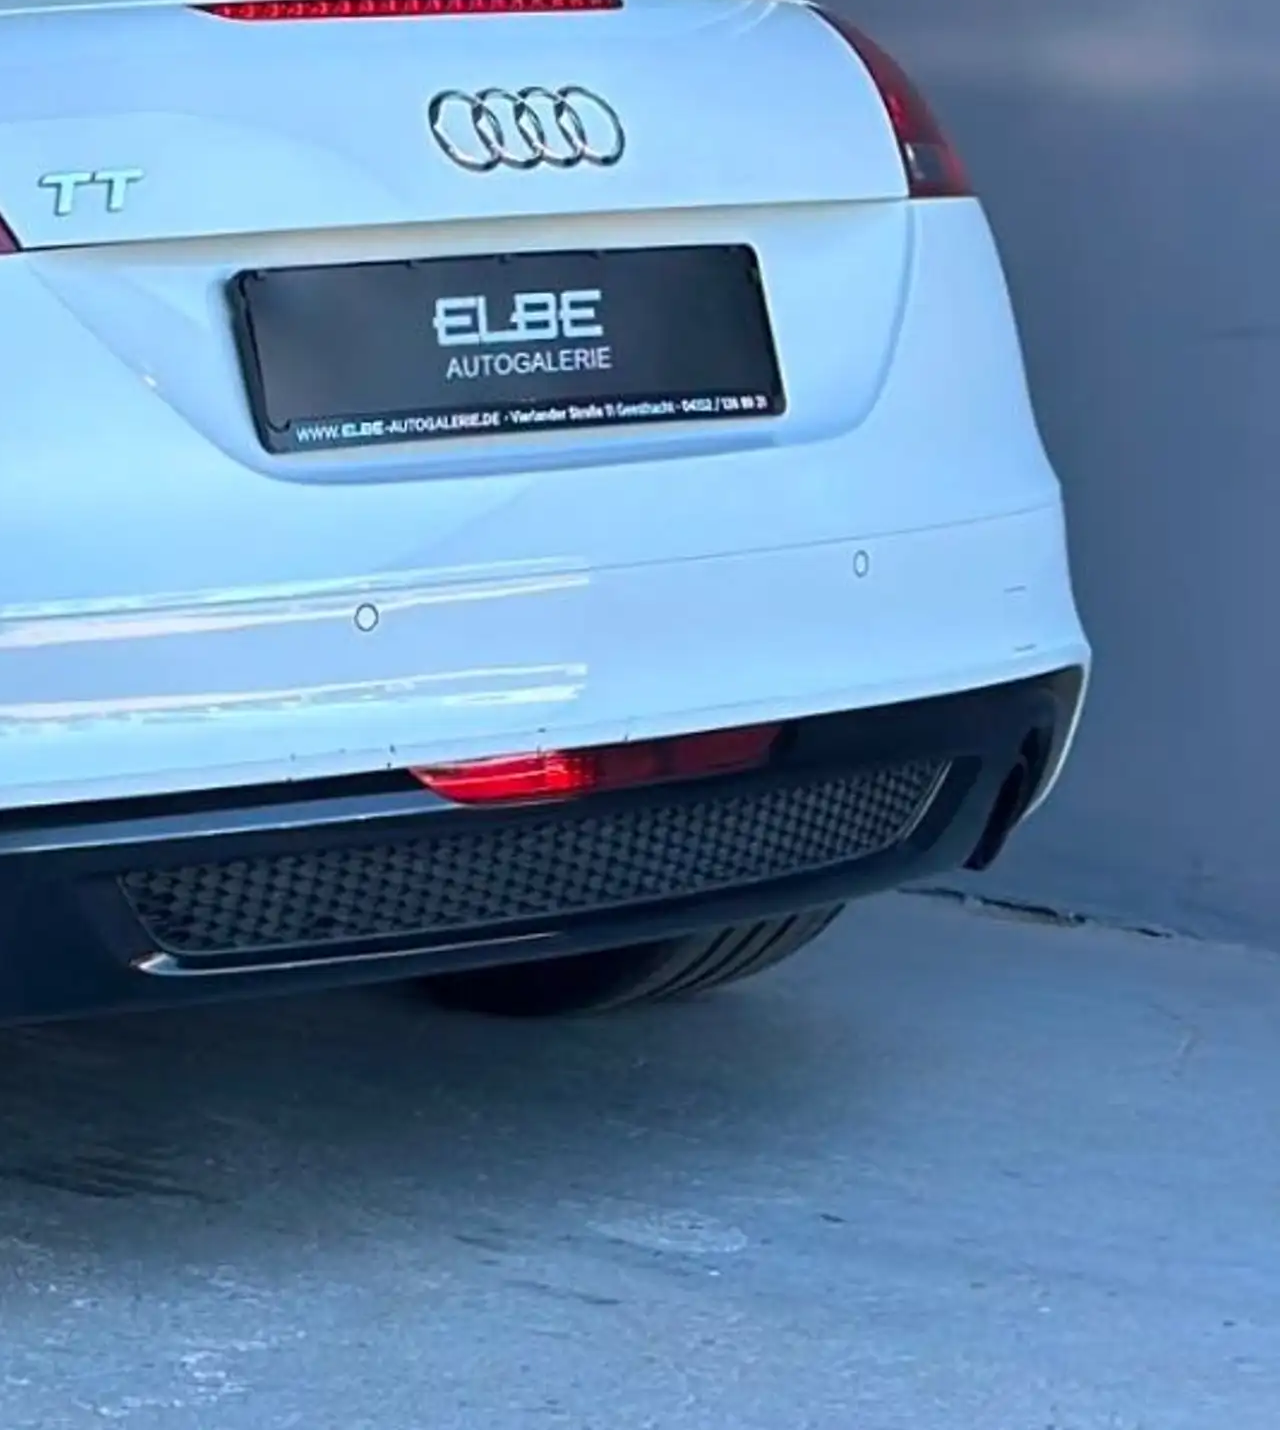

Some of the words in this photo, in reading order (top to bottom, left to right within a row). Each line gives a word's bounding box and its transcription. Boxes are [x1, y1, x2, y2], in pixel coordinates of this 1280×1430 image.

[38, 168, 144, 217] TT
[433, 289, 604, 346] ELBE
[446, 346, 613, 379] AUTOGALERIE
